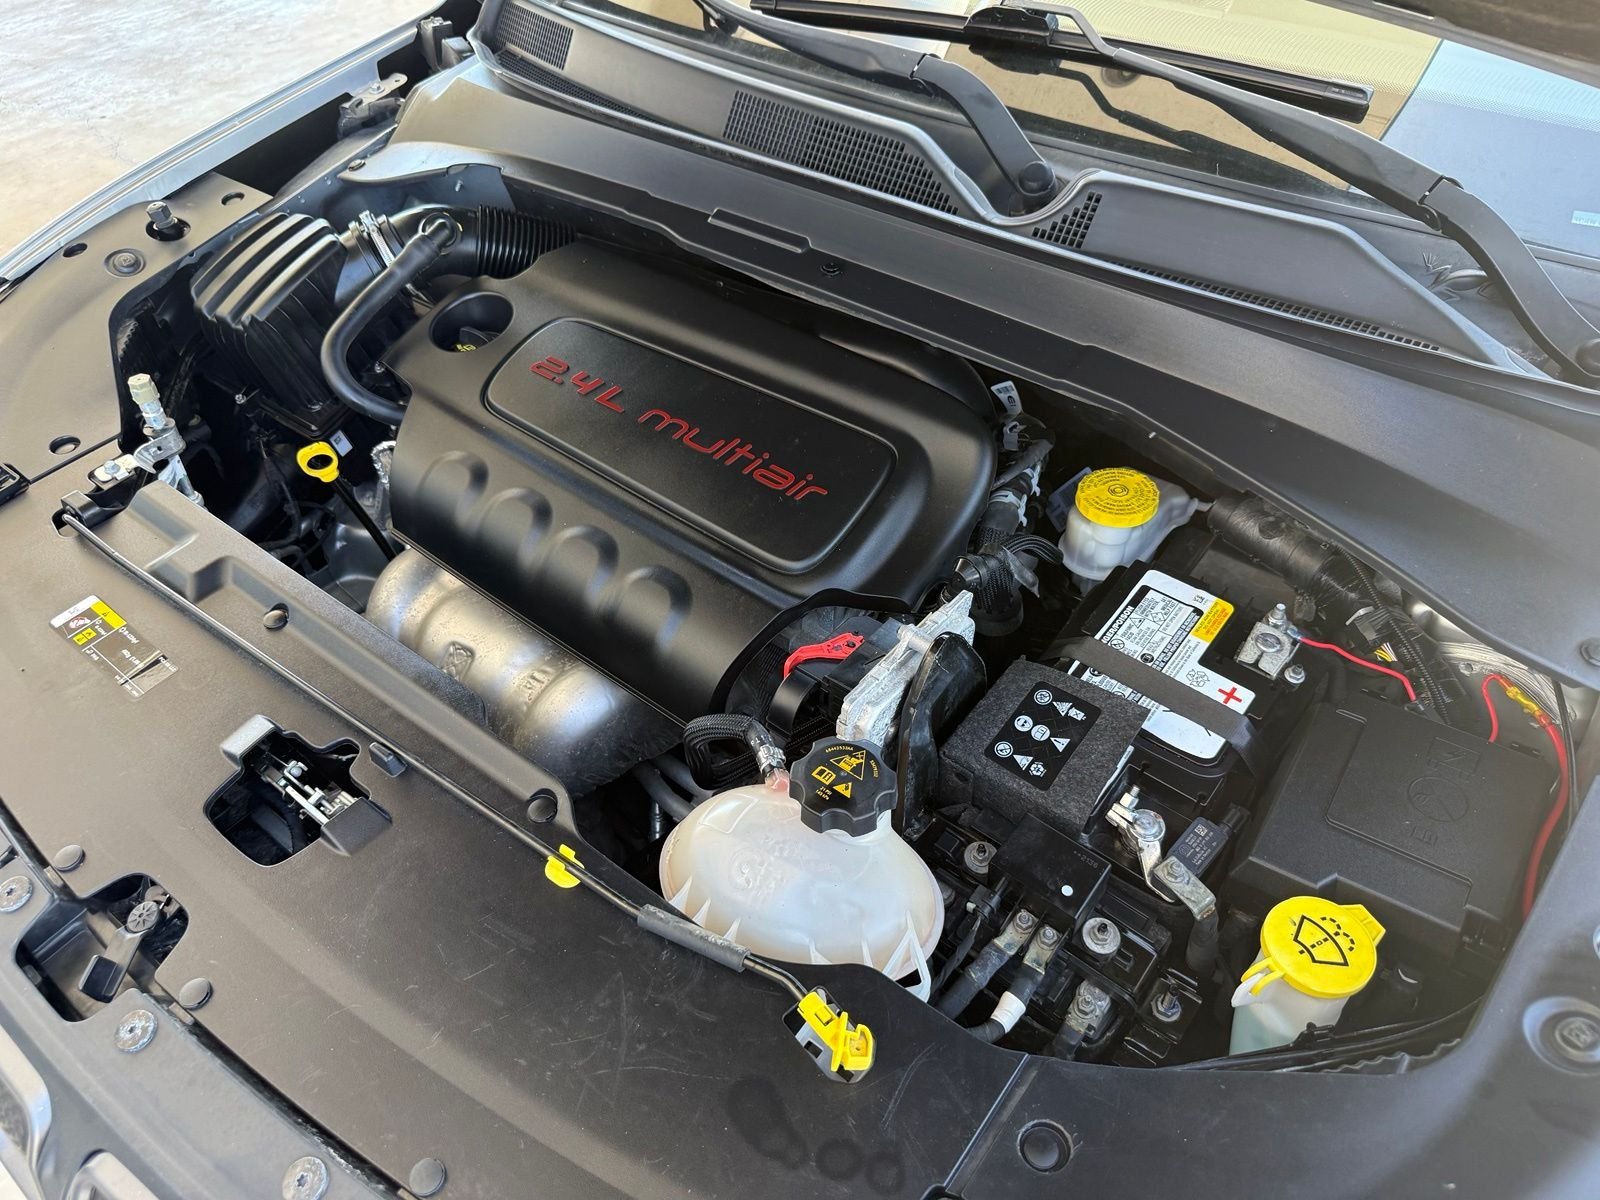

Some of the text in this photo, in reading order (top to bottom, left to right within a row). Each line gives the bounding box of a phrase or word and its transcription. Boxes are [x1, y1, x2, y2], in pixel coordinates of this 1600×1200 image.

[529, 355, 828, 500] 2.4L multiair
[1100, 604, 1134, 644] GER/POISON
